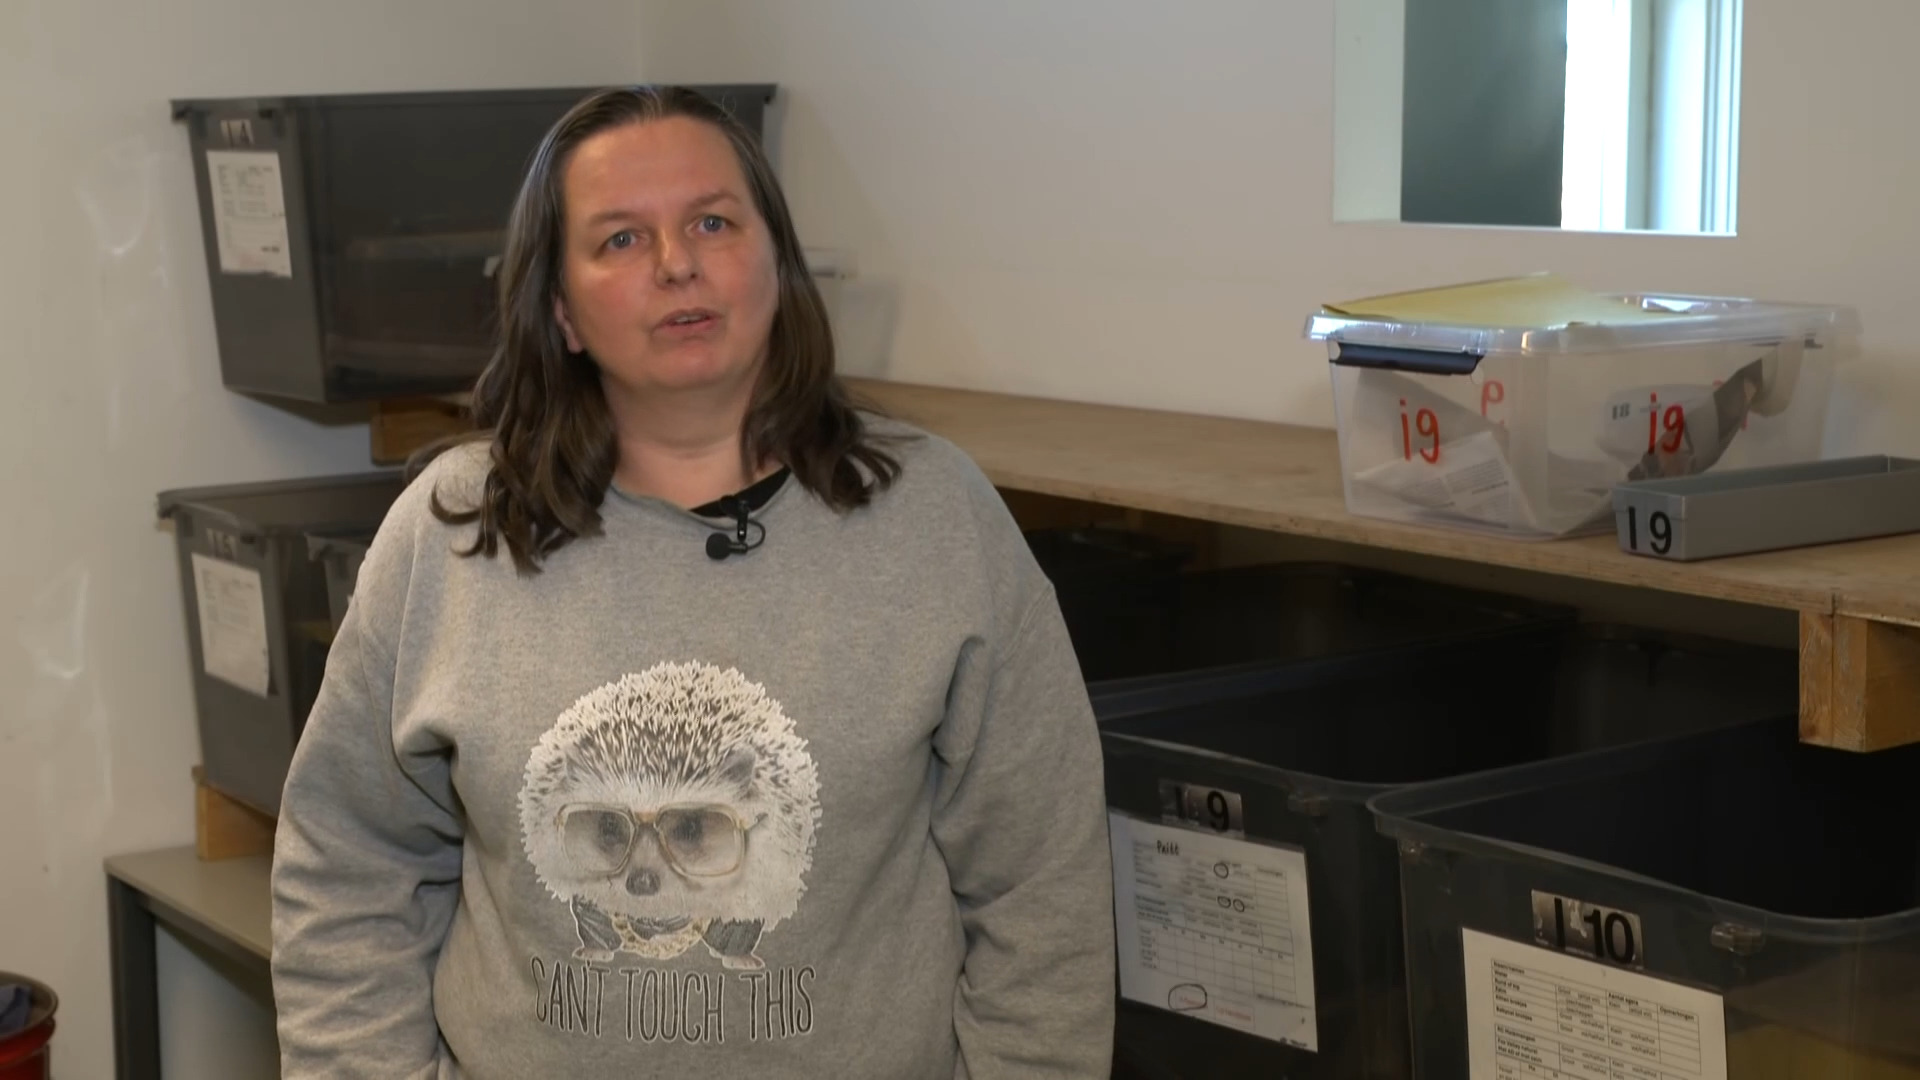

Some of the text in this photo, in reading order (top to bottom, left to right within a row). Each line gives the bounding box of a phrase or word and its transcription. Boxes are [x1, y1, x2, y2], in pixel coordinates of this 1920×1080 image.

[1584, 908, 1634, 964] 10
[531, 956, 815, 1043] CAN'T TOUCH THIS
